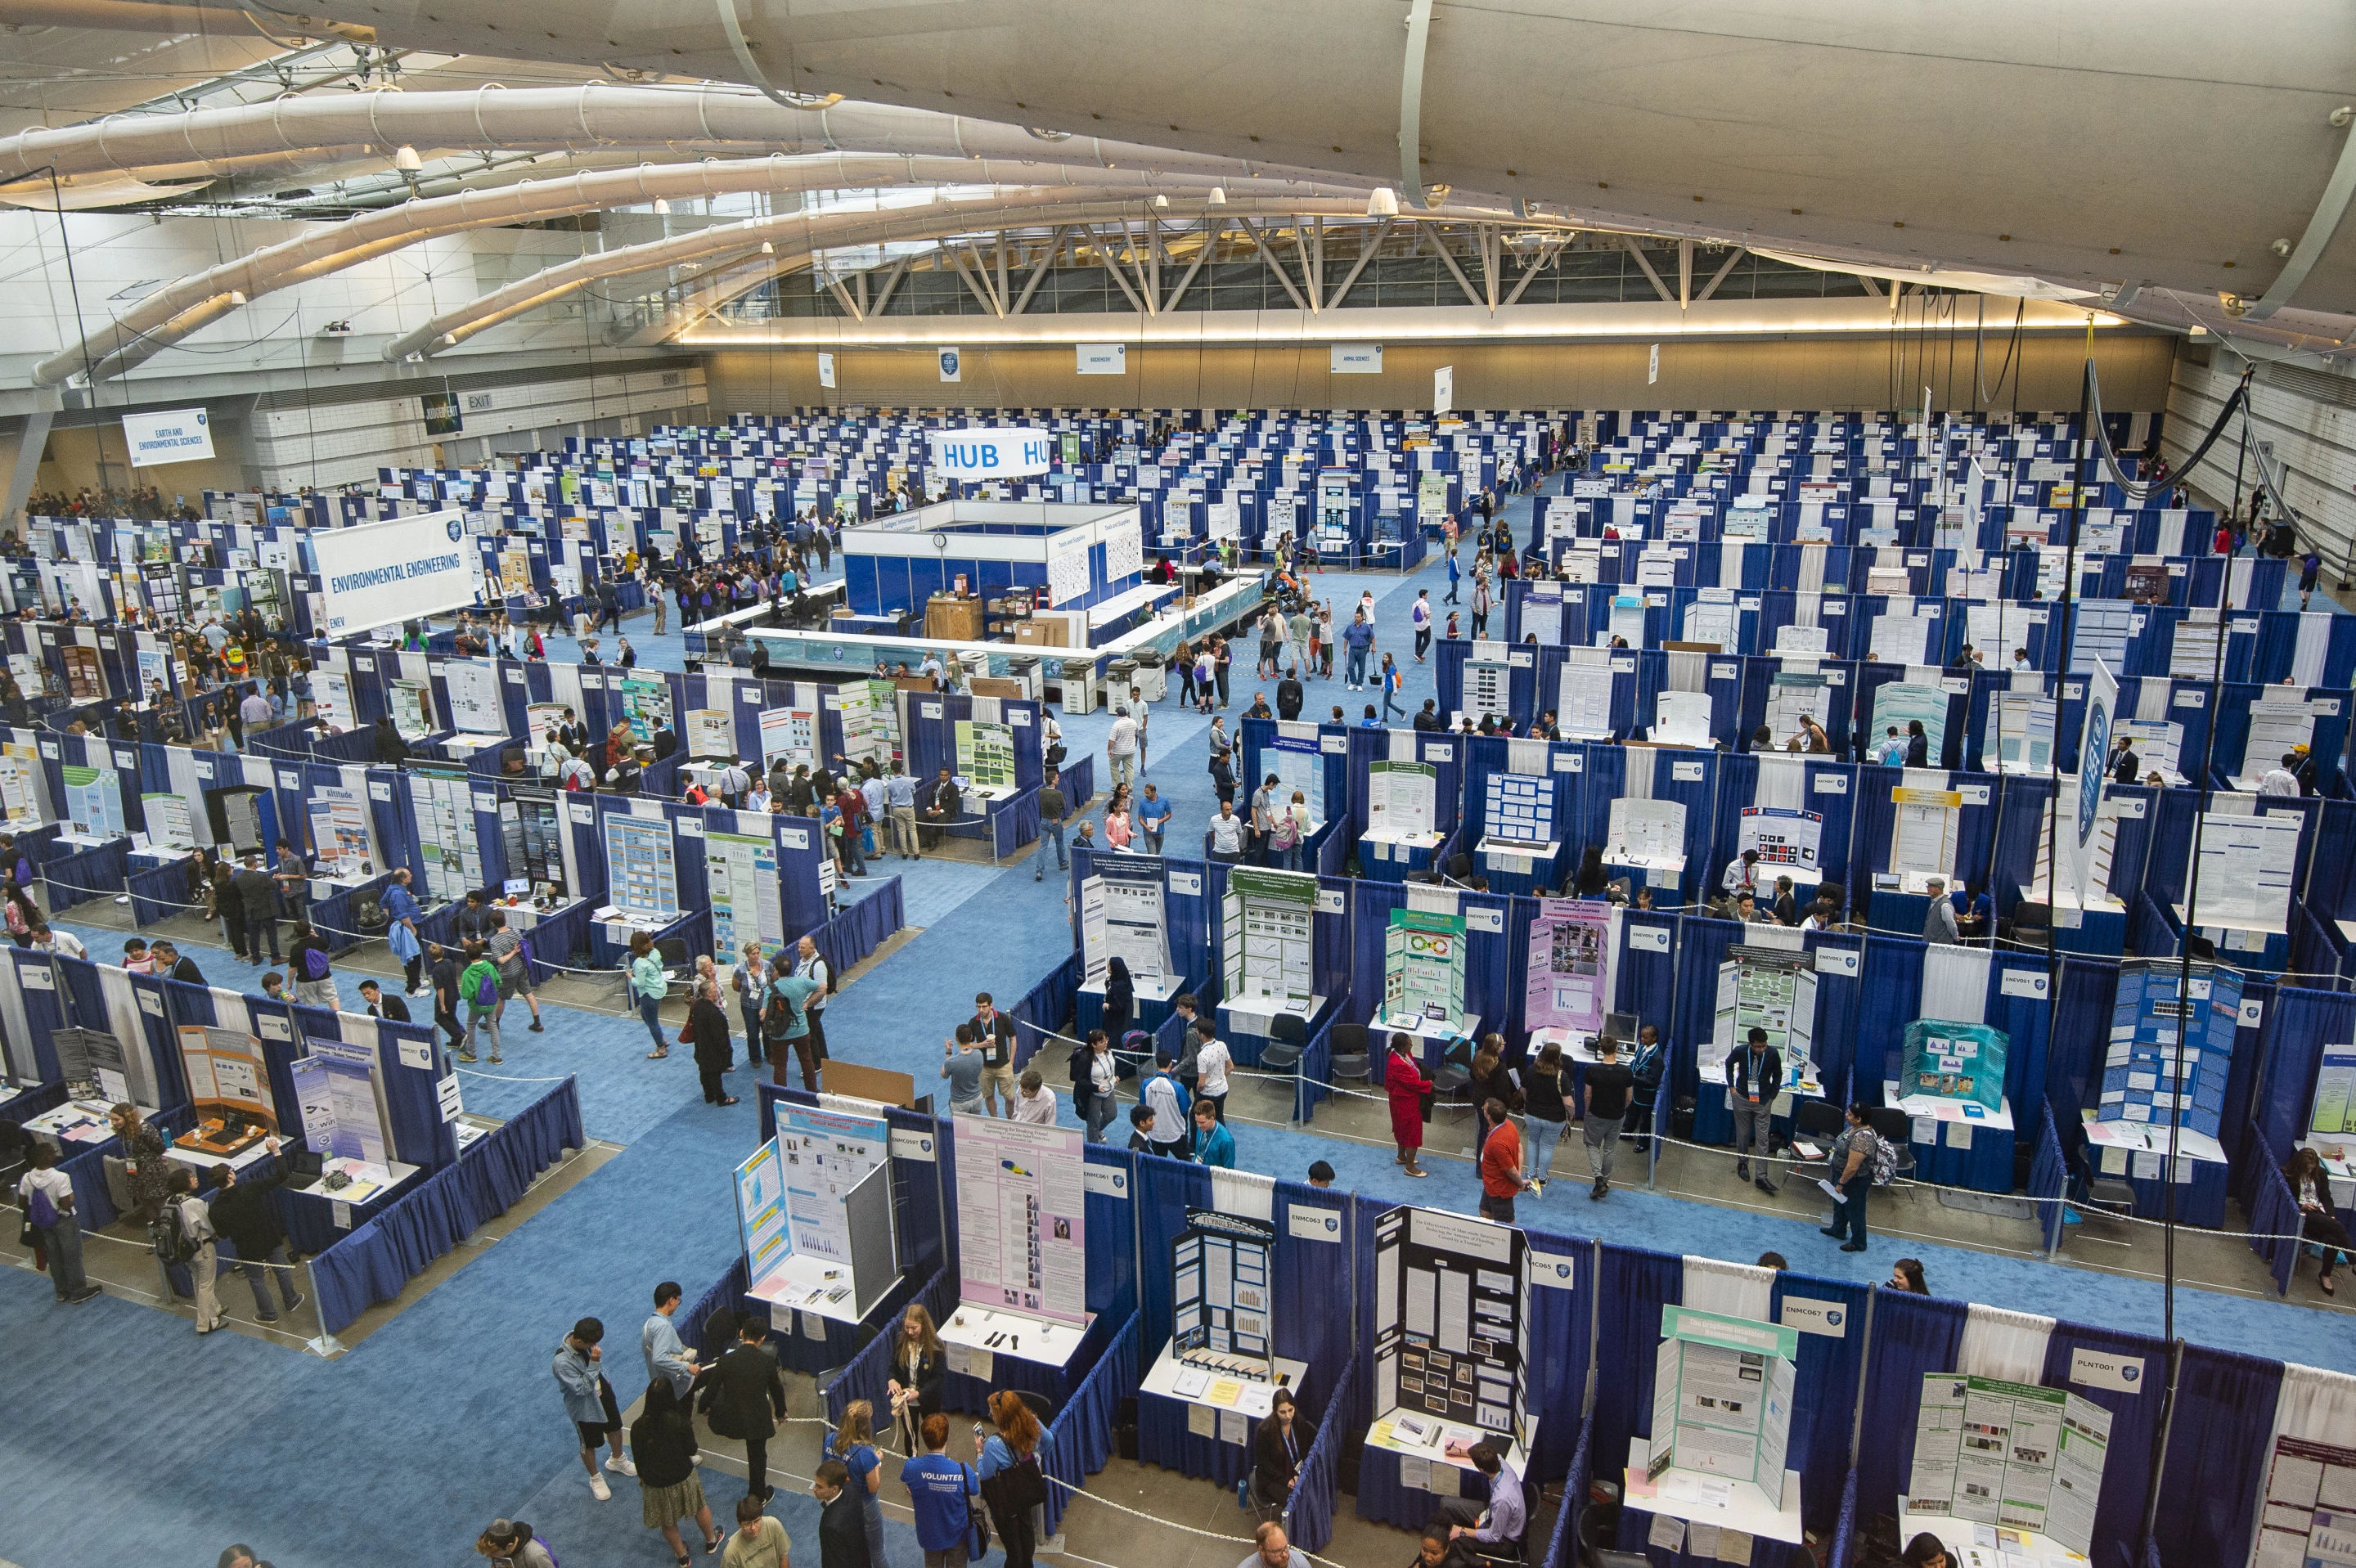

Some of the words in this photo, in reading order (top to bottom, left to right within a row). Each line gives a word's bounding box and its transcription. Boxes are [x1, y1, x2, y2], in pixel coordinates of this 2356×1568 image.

[469, 394, 490, 408] EXIT
[155, 429, 172, 438] EARTH
[173, 428, 182, 436] AND
[139, 438, 180, 450] ENVIRONMENTAL
[180, 436, 203, 445] SCIENCES
[943, 444, 999, 468] HUB
[1023, 439, 1047, 465] HU
[1118, 519, 1131, 527] Supplies
[1072, 534, 1086, 543] Supplies
[331, 564, 406, 594] ENVIRONMENTAL
[406, 553, 461, 577] ENGINEERING
[330, 616, 344, 629] ENEV
[326, 788, 353, 799] Altitude
[1083, 1171, 1109, 1179] ENMC061
[1203, 1216, 1225, 1227] FLYING
[1292, 1214, 1321, 1224] ENMC063
[1423, 1221, 1451, 1230] Effectiveness
[1426, 1226, 1446, 1235] Reducing
[1476, 1238, 1495, 1246] Flooding
[1464, 1239, 1481, 1247] Tsunami
[1786, 1306, 1822, 1316] ENMC067
[1689, 1318, 1702, 1327] The
[1702, 1320, 1733, 1332] Graphene
[1733, 1325, 1765, 1339] Insulated
[2078, 1359, 2115, 1372] PLNT001
